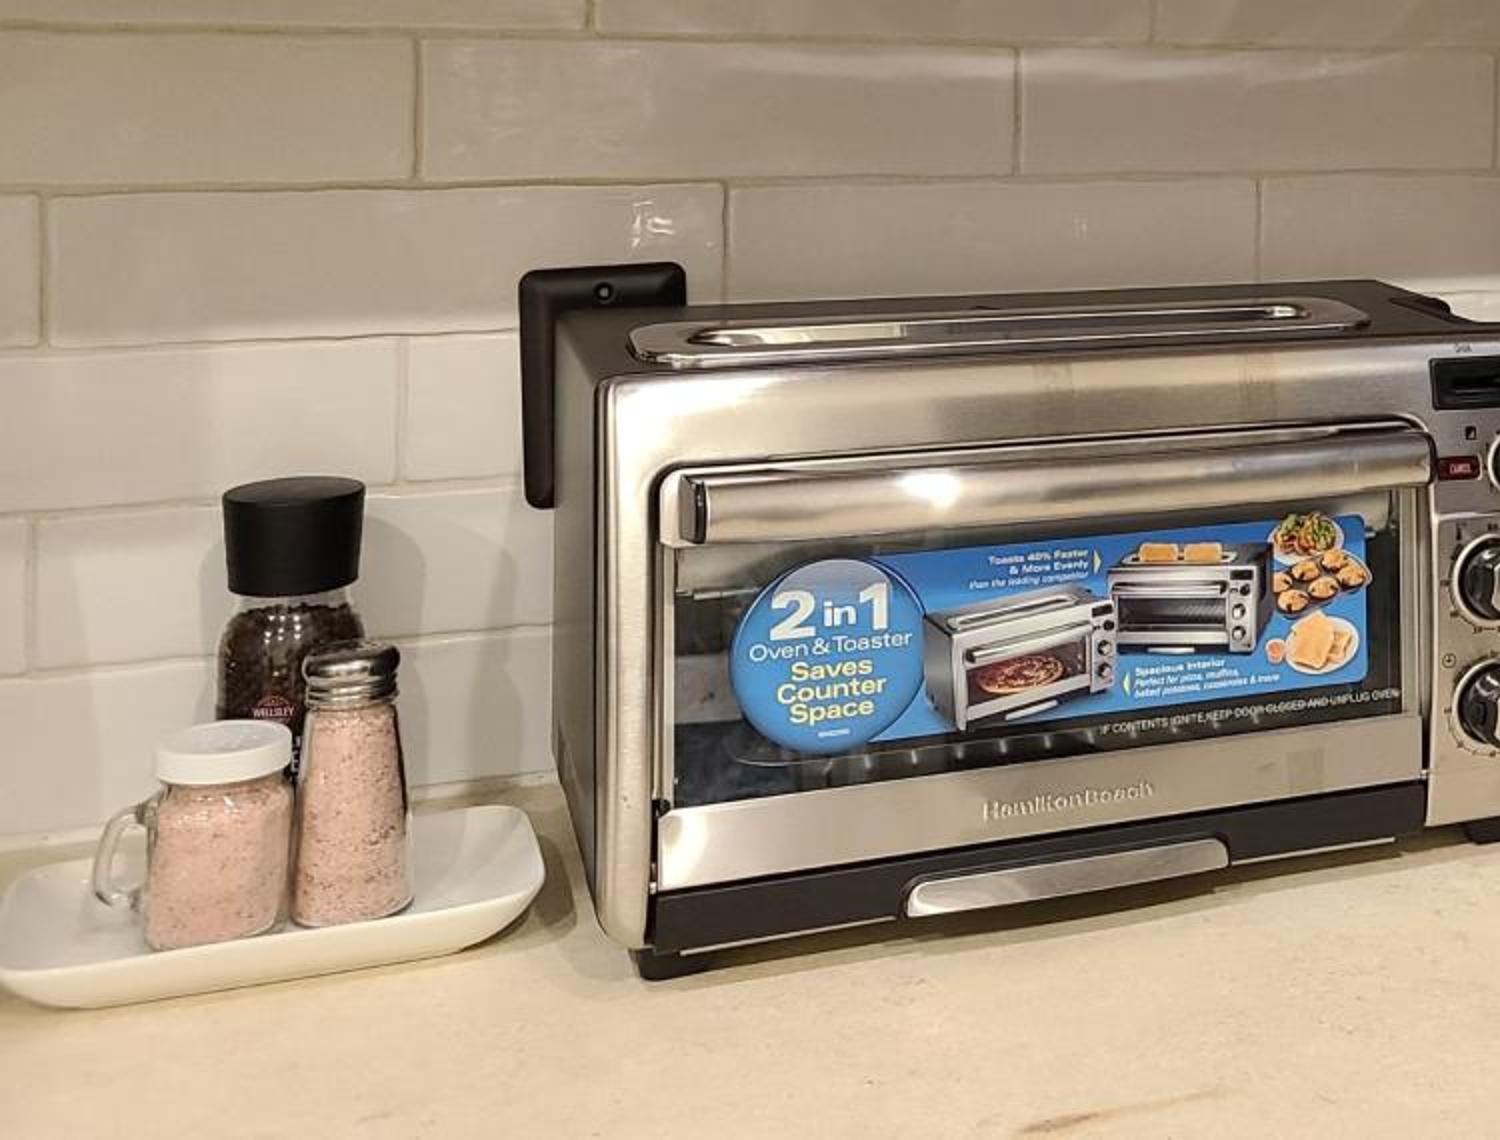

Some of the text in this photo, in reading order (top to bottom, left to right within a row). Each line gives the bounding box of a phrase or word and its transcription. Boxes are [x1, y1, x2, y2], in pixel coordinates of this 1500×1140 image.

[1021, 562, 1051, 574] More
[1053, 559, 1089, 572] Evenly
[768, 582, 888, 642] 2 in 1
[750, 631, 913, 662] Oven & Toaster
[791, 659, 874, 682] Saves
[777, 677, 888, 705] Counter
[789, 699, 875, 727] Space
[1112, 717, 1169, 734] CONTENTS
[1307, 696, 1329, 709] AND
[1330, 692, 1371, 707] UNPLUG
[1372, 688, 1400, 701] OVEN
